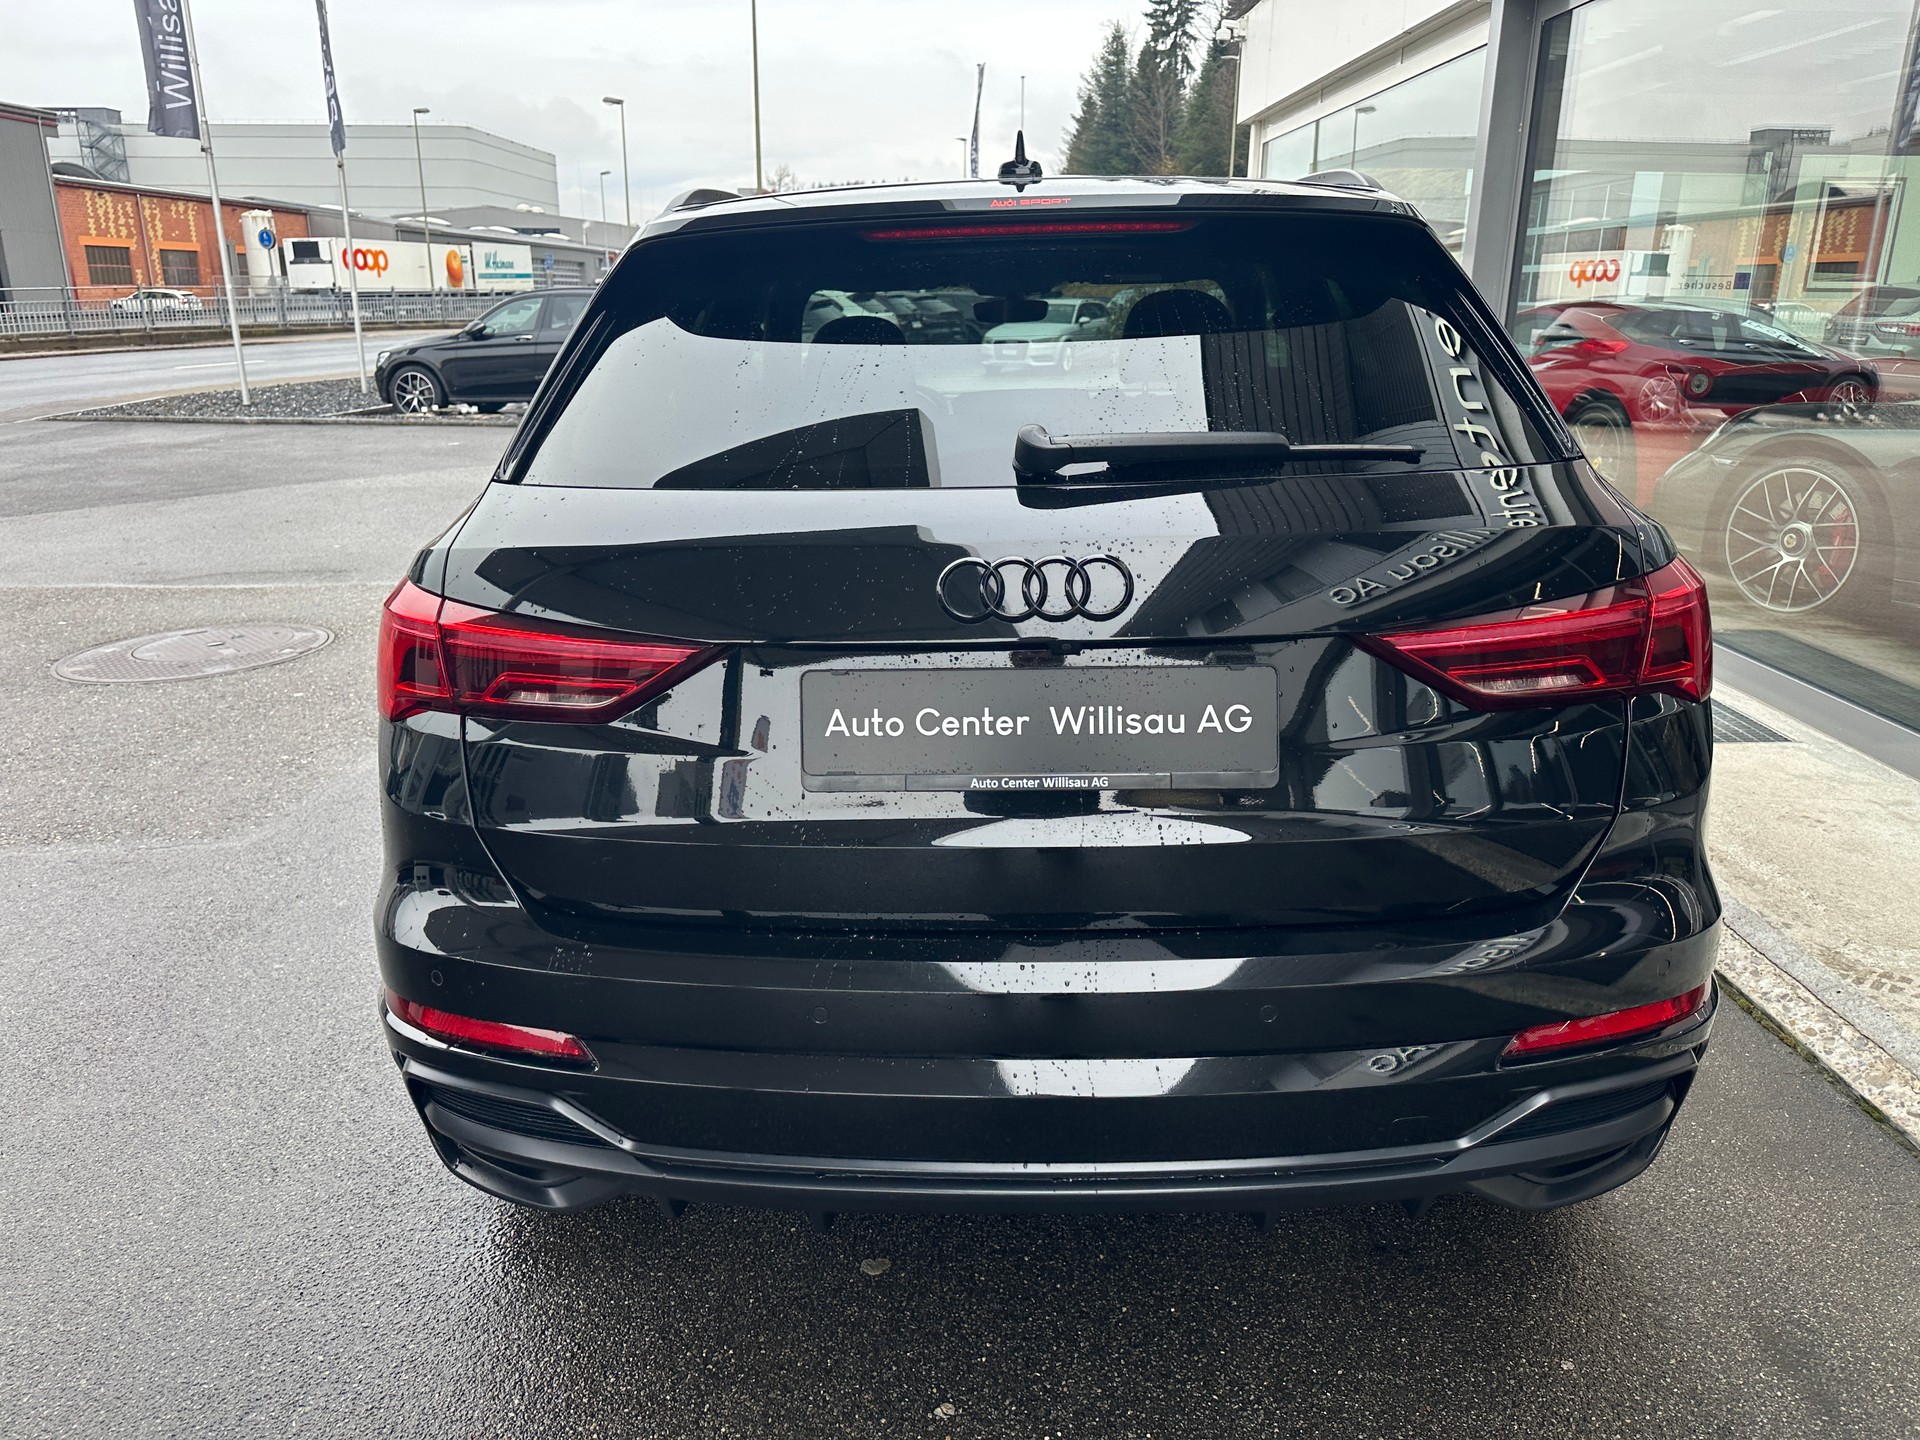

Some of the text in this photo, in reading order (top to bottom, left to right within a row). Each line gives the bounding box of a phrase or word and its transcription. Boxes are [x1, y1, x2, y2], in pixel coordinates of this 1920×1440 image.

[990, 197, 1072, 208] Audi SPORT
[824, 703, 1254, 738] Auto Center Willisau AG
[970, 776, 1109, 789] Auto Center Willisau AG
